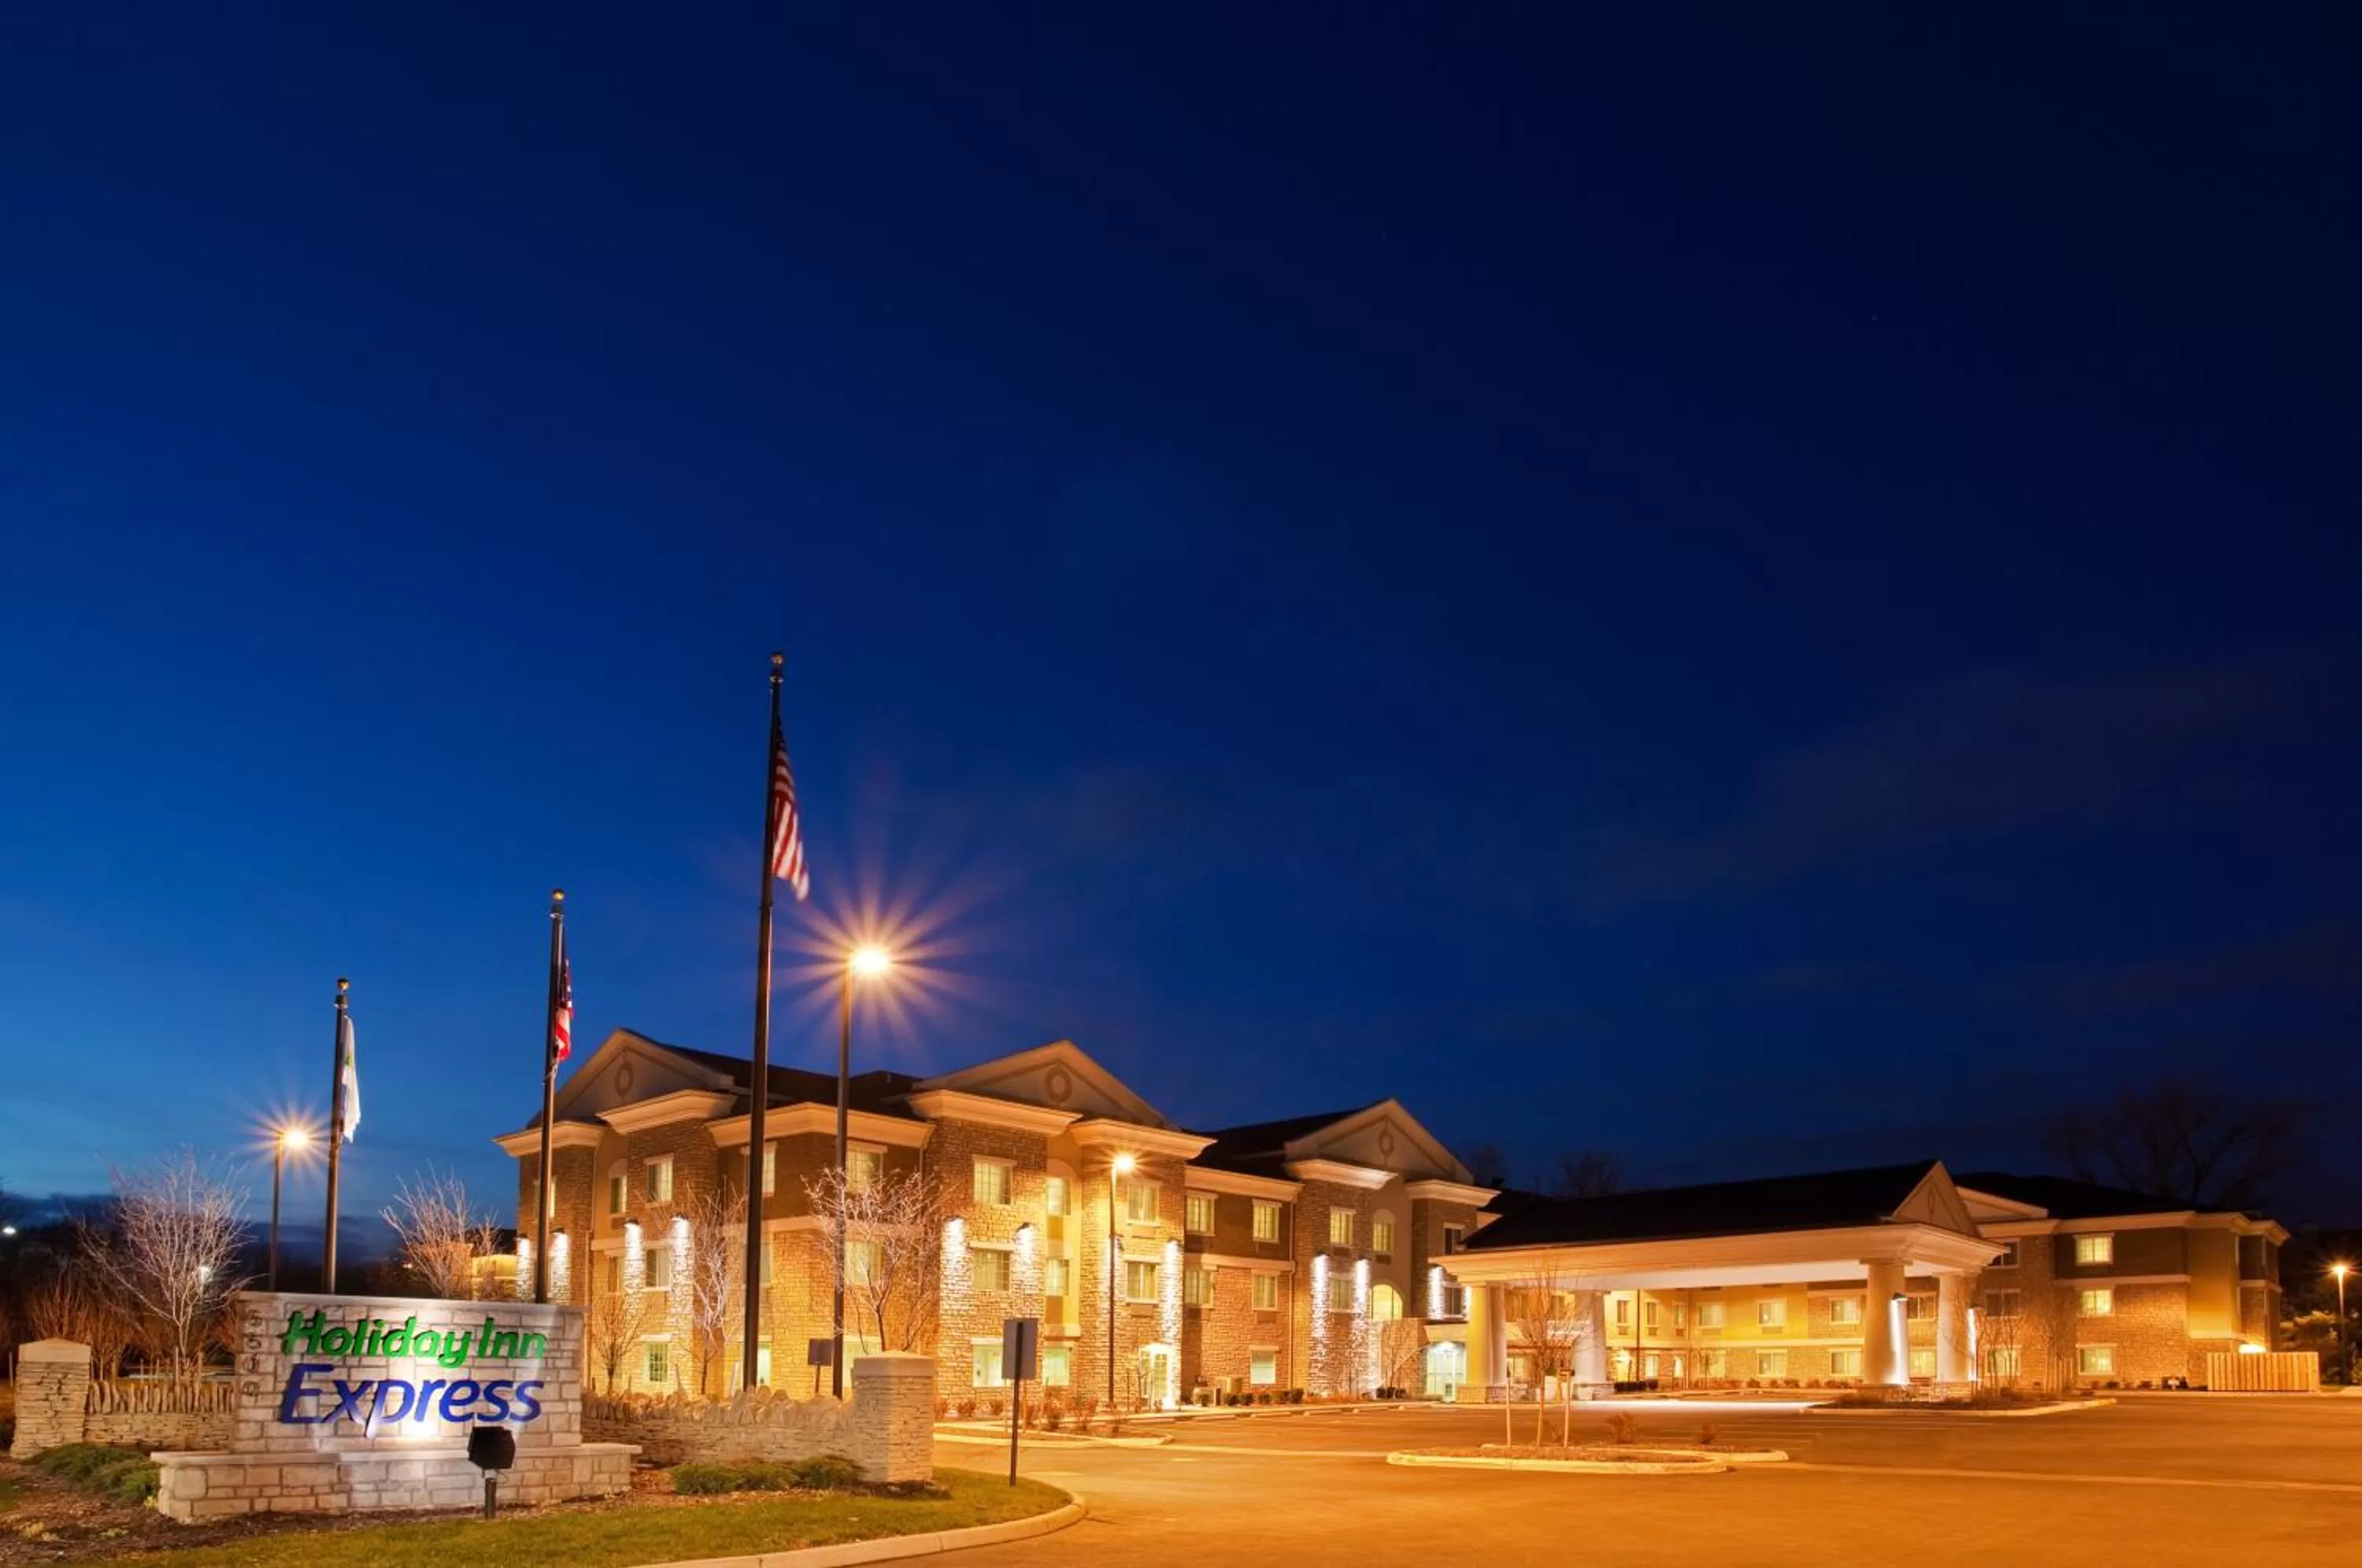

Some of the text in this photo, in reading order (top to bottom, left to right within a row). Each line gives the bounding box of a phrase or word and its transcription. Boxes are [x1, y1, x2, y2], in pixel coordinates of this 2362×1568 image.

[282, 1309, 547, 1368] Holiday Inn
[280, 1363, 545, 1439] Express
